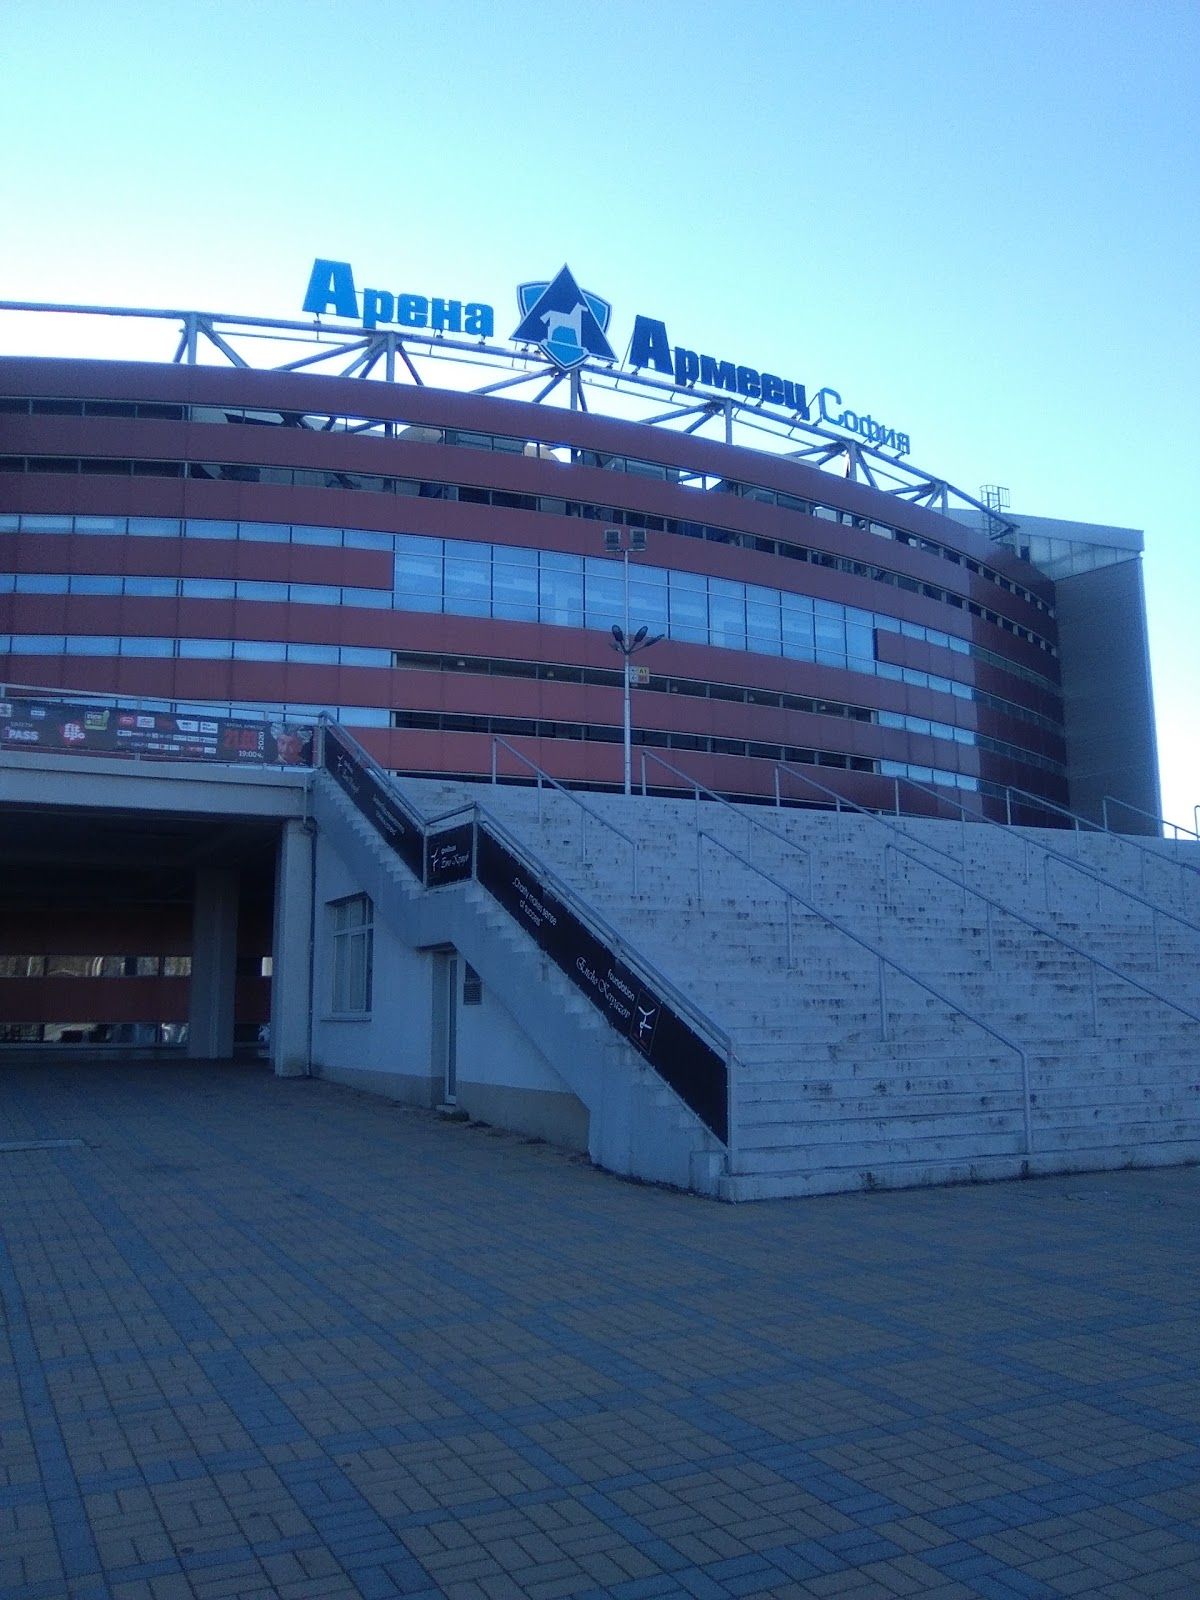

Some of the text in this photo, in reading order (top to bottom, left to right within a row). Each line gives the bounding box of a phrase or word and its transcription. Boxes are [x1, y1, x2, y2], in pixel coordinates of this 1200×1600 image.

[303, 258, 811, 420] Арена Армеец
[819, 387, 911, 455] София
[9, 729, 39, 741] PASS
[607, 968, 635, 1002] foundation
